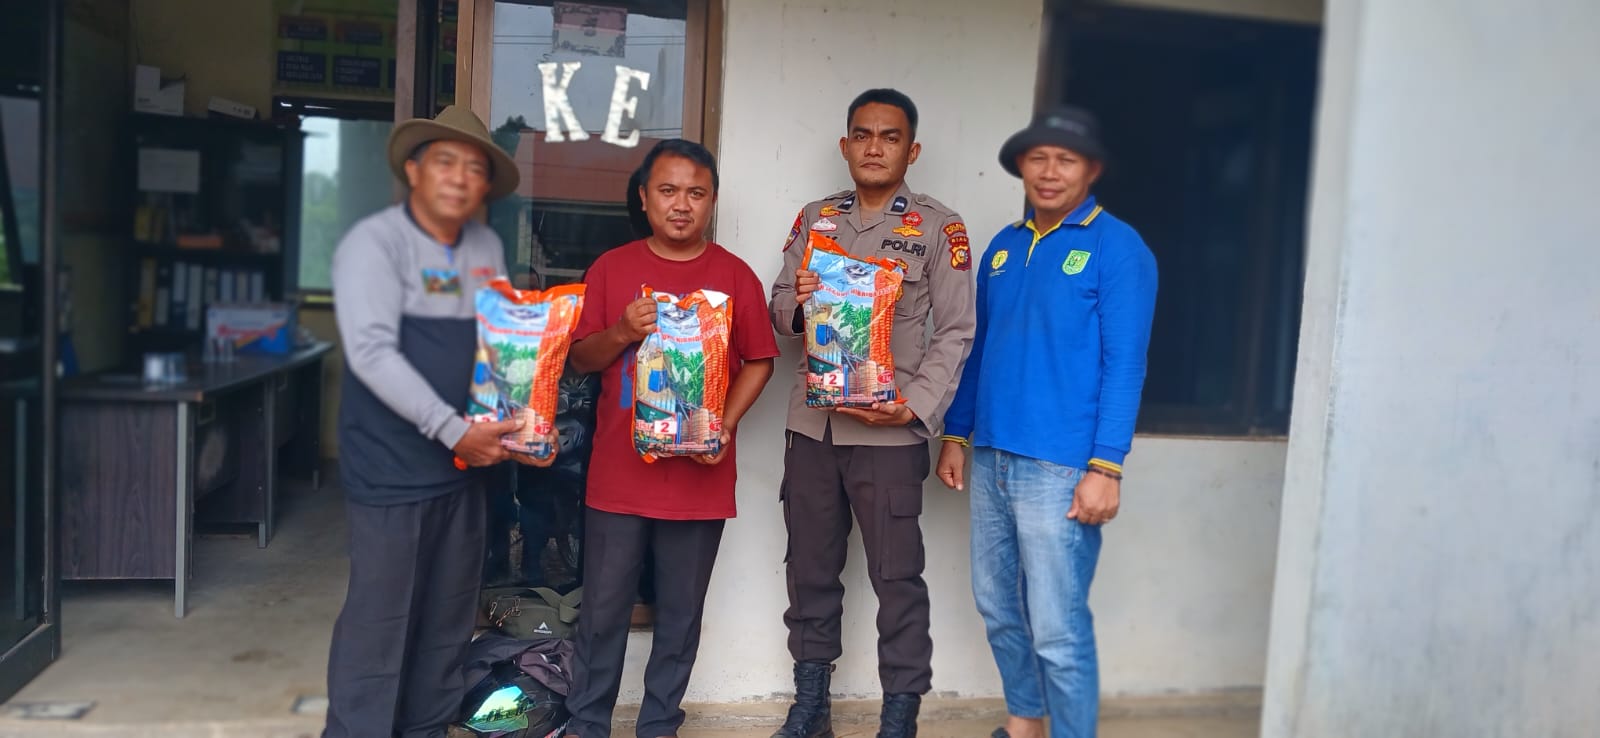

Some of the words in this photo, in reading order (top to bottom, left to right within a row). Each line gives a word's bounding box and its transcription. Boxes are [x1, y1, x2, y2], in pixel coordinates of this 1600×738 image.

[881, 239, 927, 256] POLRI
[829, 374, 837, 385] 2
[660, 422, 670, 433] 2
